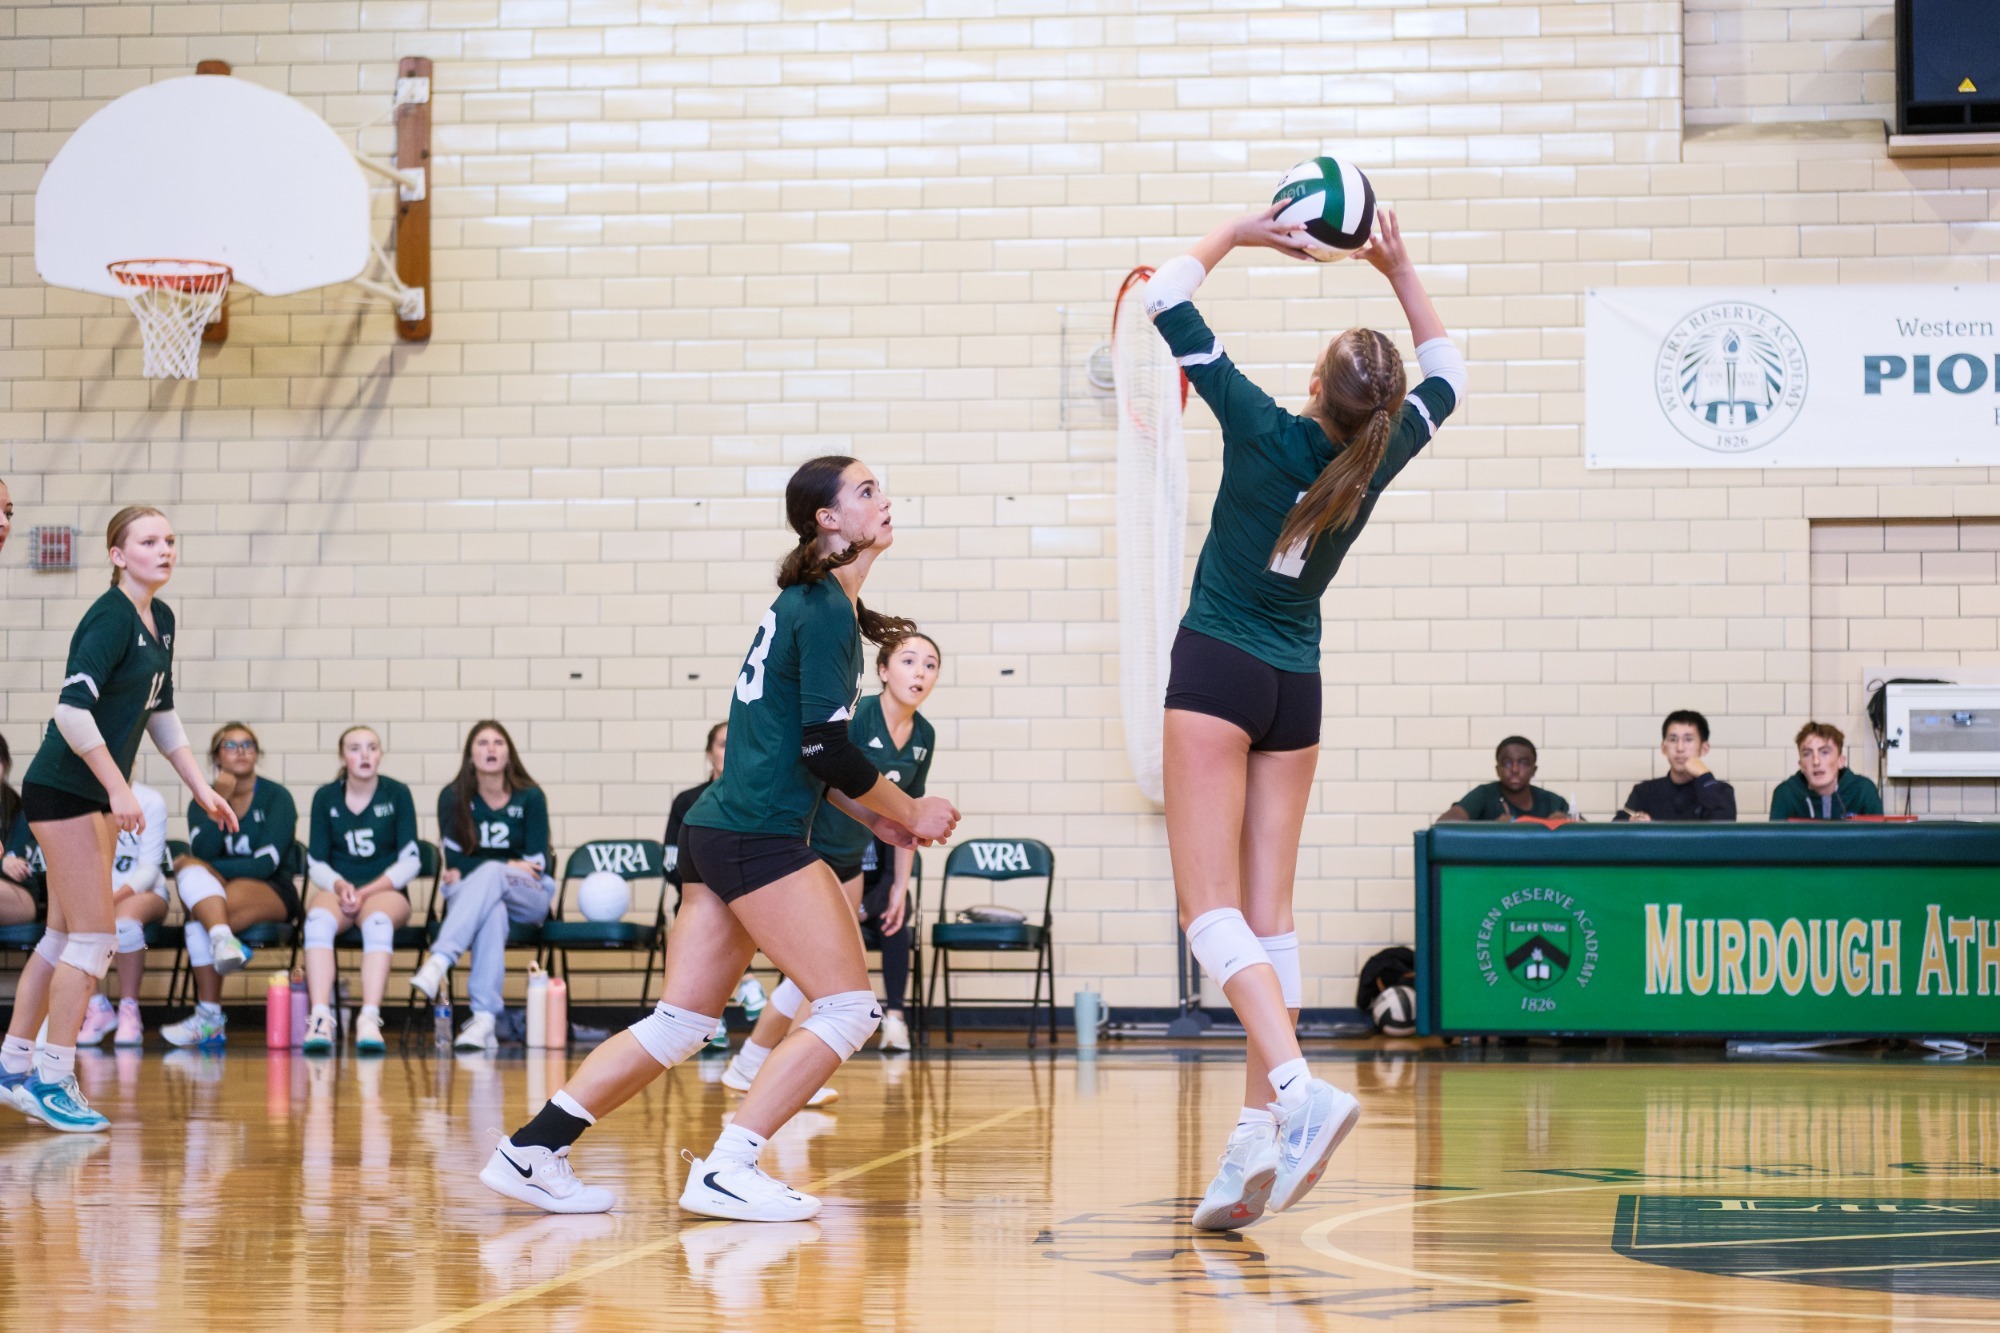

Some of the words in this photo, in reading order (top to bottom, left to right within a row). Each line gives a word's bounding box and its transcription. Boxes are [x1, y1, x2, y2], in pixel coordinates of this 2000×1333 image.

[1896, 318, 1993, 337] Western
[1660, 328, 1689, 412] WESTERN
[1688, 306, 1770, 330] RESERVE
[1770, 325, 1804, 412] ACADEMY
[1864, 353, 2000, 395] PIO
[1717, 435, 1749, 448] 1826
[224, 833, 252, 856] 14
[344, 828, 376, 858] 15
[479, 821, 510, 848] 12
[586, 843, 650, 874] WRA
[968, 842, 1032, 872] WRA
[1477, 907, 1502, 987] WESTERN
[1501, 887, 1575, 911] RESERVE
[1573, 909, 1599, 988] ACADEMY
[1645, 903, 1902, 996] MURDOUGH
[1916, 904, 2000, 996] ATH
[1521, 997, 1556, 1012] 1826
[1694, 1199, 1981, 1213] Lux
